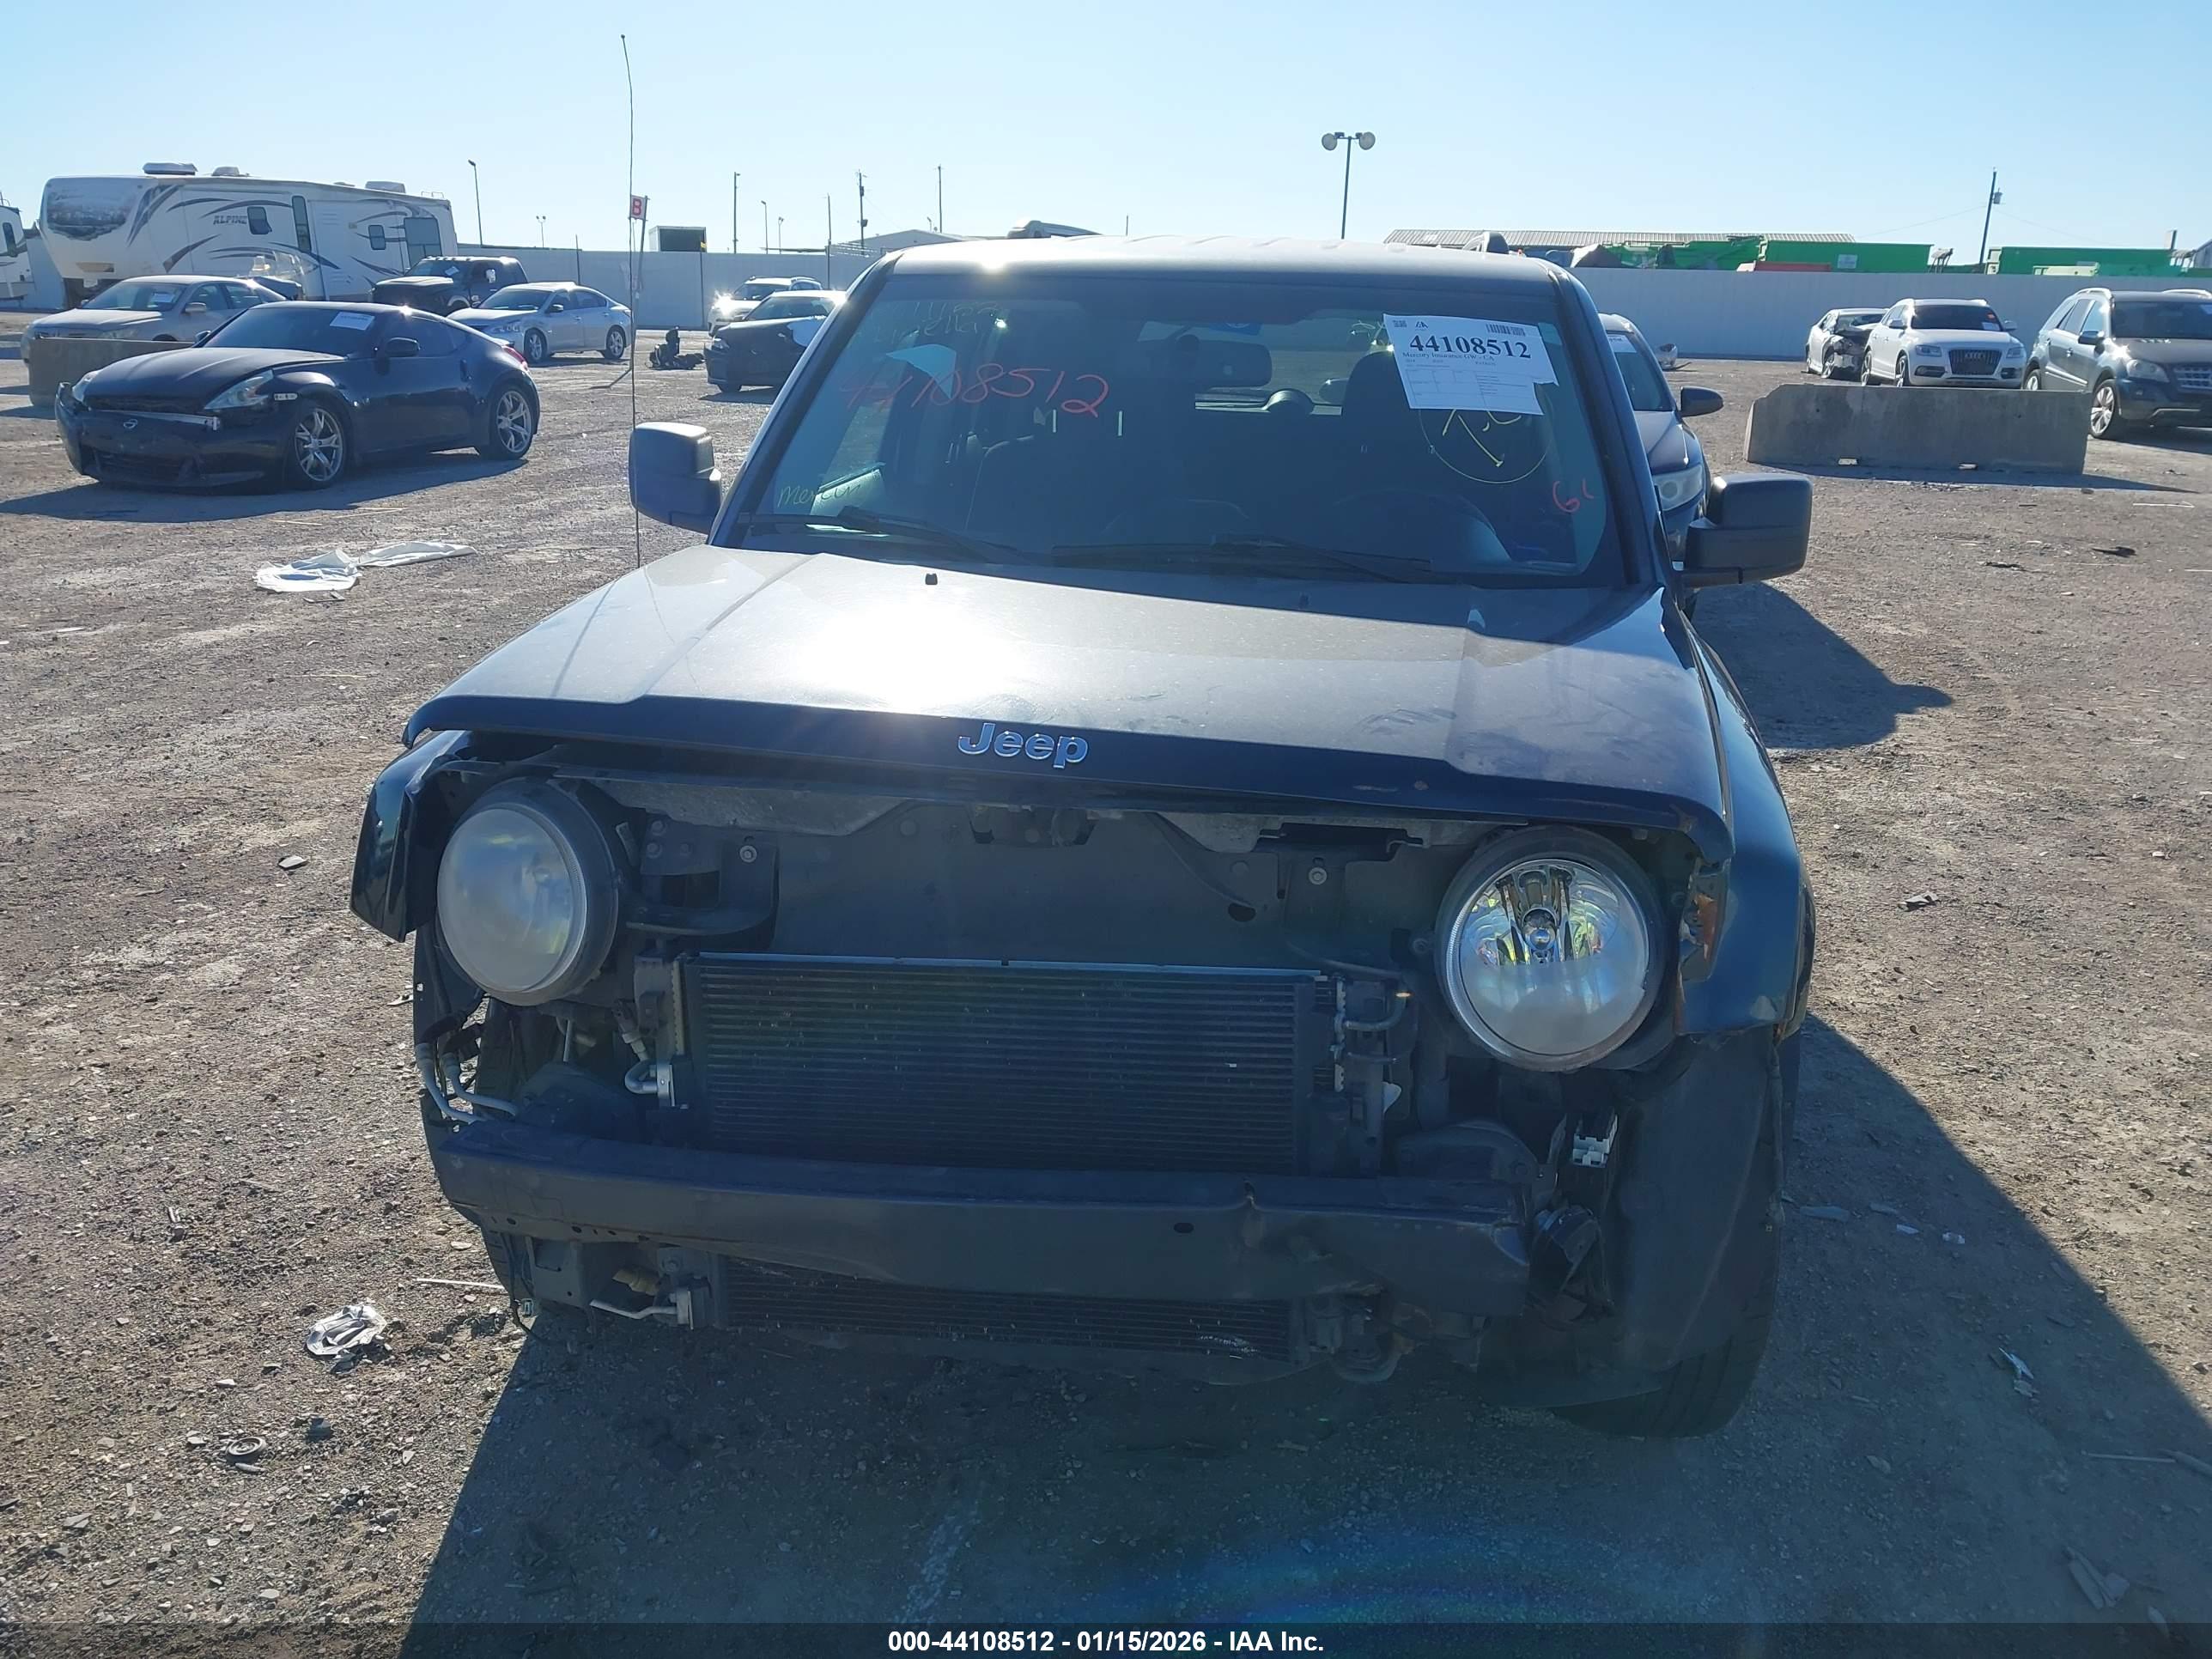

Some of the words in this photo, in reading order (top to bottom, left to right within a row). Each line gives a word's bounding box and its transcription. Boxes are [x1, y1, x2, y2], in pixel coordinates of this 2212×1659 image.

[213, 215, 248, 225] ALPINE
[1410, 335, 1530, 358] 44108512
[957, 722, 1089, 769] Jeep
